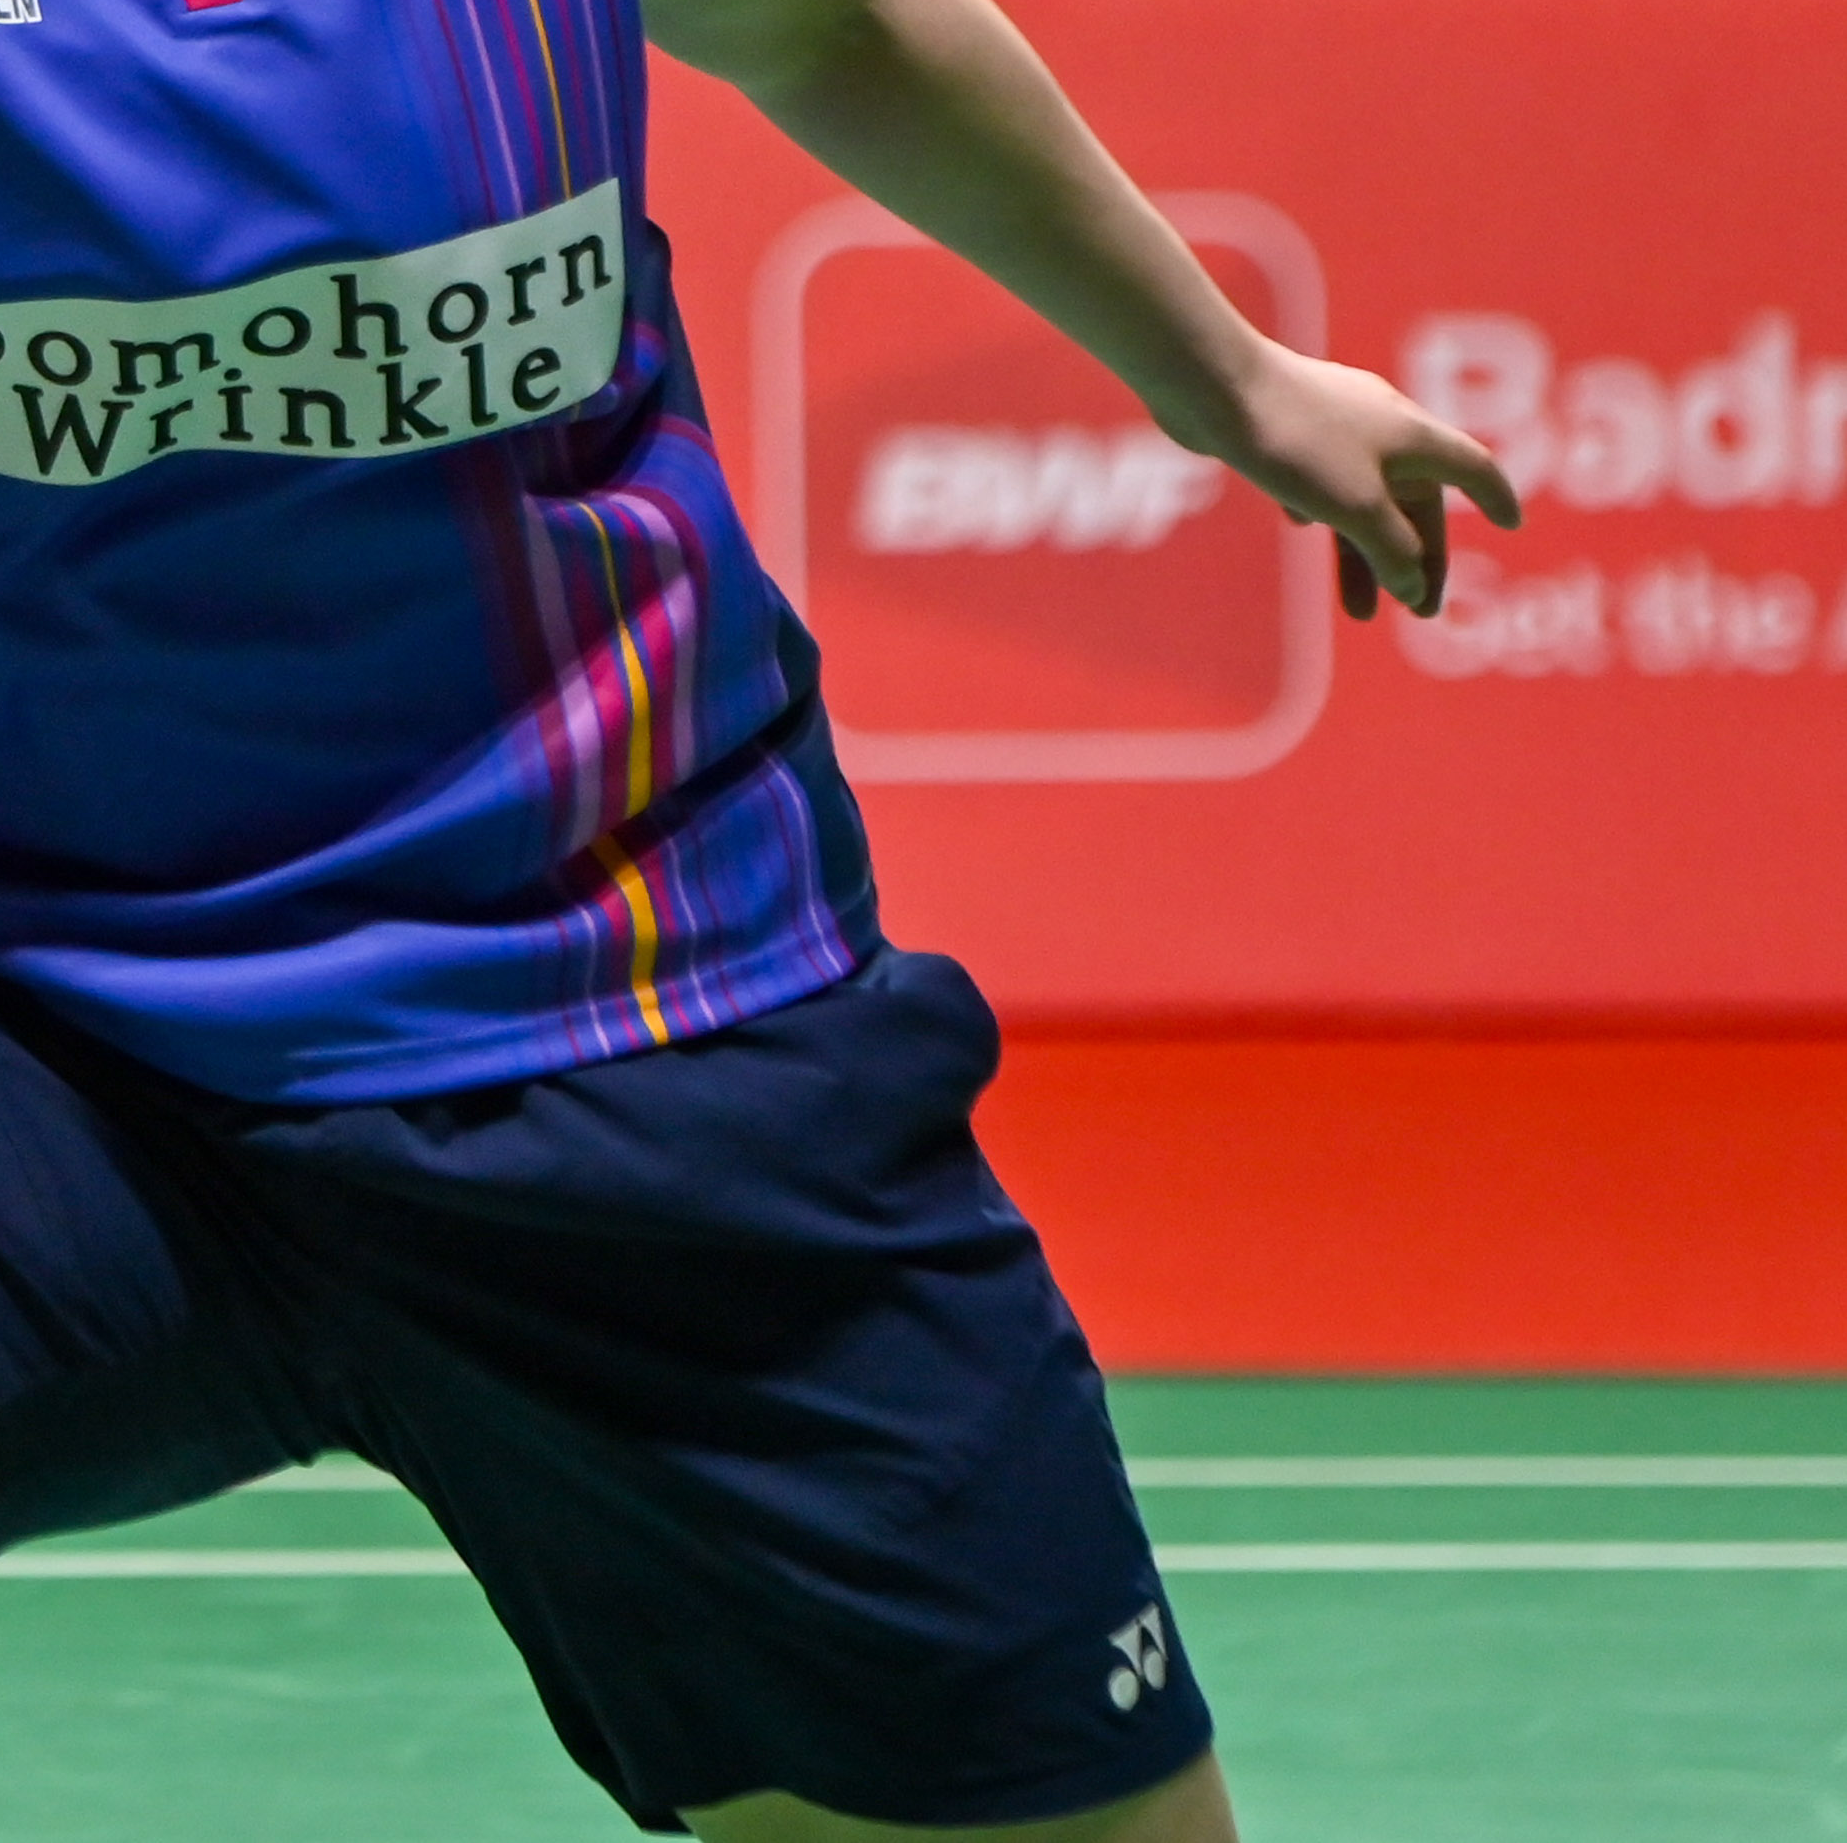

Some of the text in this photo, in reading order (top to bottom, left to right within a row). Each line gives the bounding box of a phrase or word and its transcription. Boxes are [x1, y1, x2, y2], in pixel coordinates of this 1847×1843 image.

[13, 344, 563, 478] Wrinkle
[855, 425, 1222, 550] BWF
[1621, 547, 1815, 675] the
